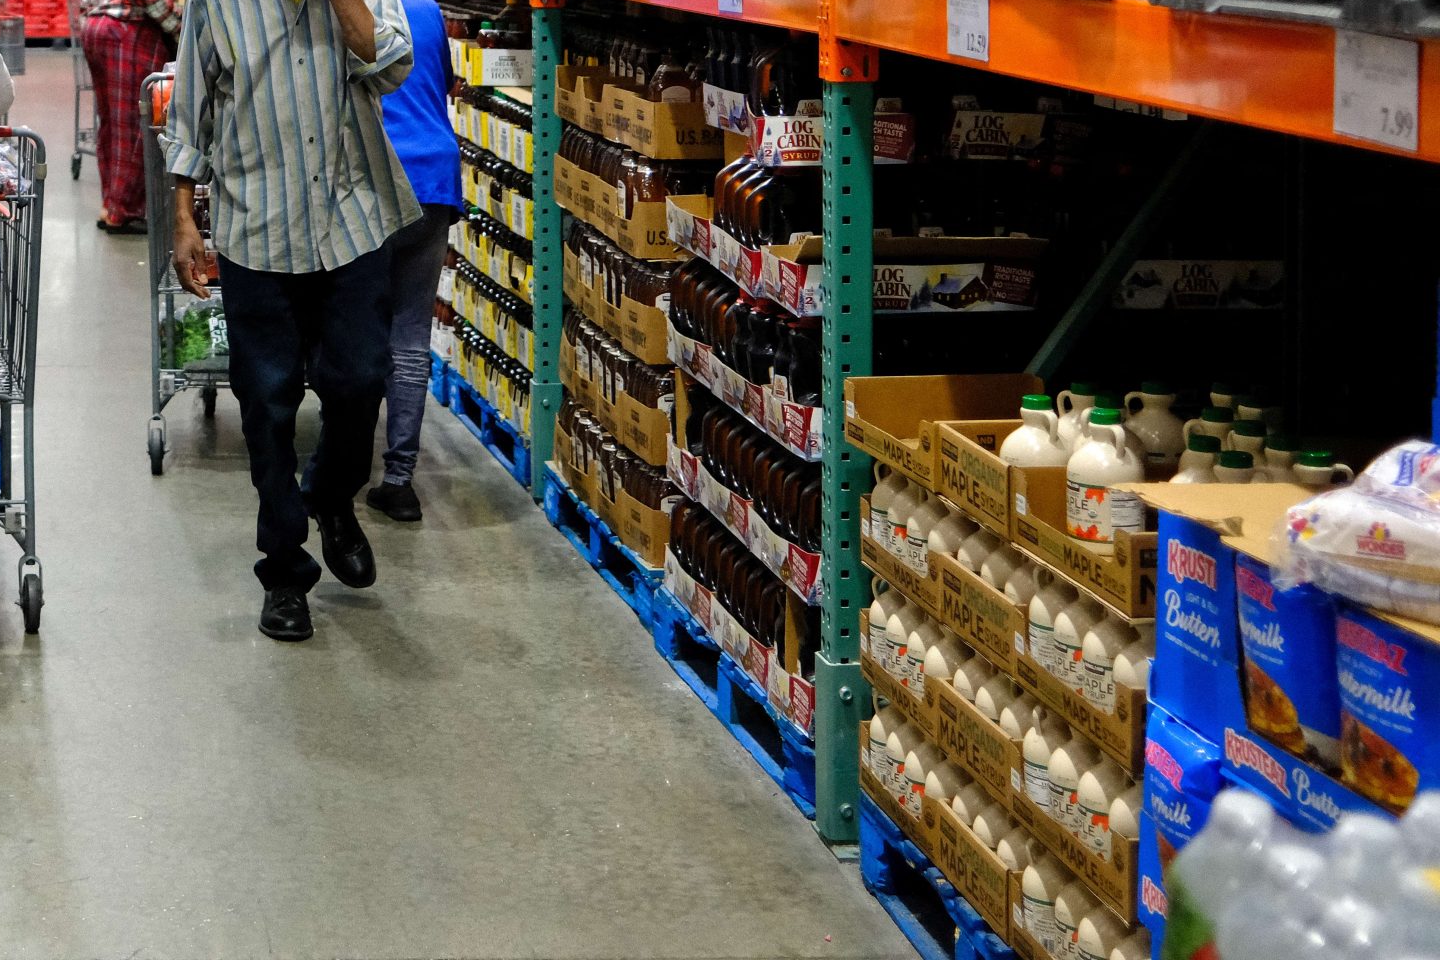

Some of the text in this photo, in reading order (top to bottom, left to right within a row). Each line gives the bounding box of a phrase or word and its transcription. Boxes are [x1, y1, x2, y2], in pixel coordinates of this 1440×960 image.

[491, 72, 523, 80] HONEY
[783, 120, 814, 135] LOG
[974, 115, 1005, 130] LOG
[1380, 106, 1414, 138] 7.99
[676, 129, 700, 145] U.S.
[884, 128, 904, 138] TASTE
[965, 128, 1011, 146] CABIN
[776, 134, 822, 150] CABIN
[763, 149, 773, 158] 2
[782, 152, 818, 160] SYRUP
[646, 230, 670, 246] U.S.
[993, 264, 1035, 278] TRADITIONAL
[994, 271, 1031, 285] RICH TASTE
[1181, 264, 1213, 279] LOG
[992, 280, 1003, 288] NO
[1172, 278, 1221, 293] CABIN
[805, 296, 813, 305] 2
[995, 291, 1007, 299] NO
[883, 439, 931, 477] MAPLE SYRUP
[959, 448, 1006, 496] ORGANIC
[941, 460, 1006, 518] MAPLE SYRUP
[1357, 537, 1405, 558] WONDER
[1063, 543, 1103, 588] MAPLE
[893, 562, 922, 594] MAPLE
[942, 591, 1011, 657] MAPLE SYRUP
[1061, 692, 1103, 735] MAPLE
[939, 720, 1006, 788] MAPLE SYRUP
[1224, 726, 1292, 800] KRUSTEAZ
[940, 839, 979, 895] MAPLE
[1060, 833, 1098, 886] MAPLE
